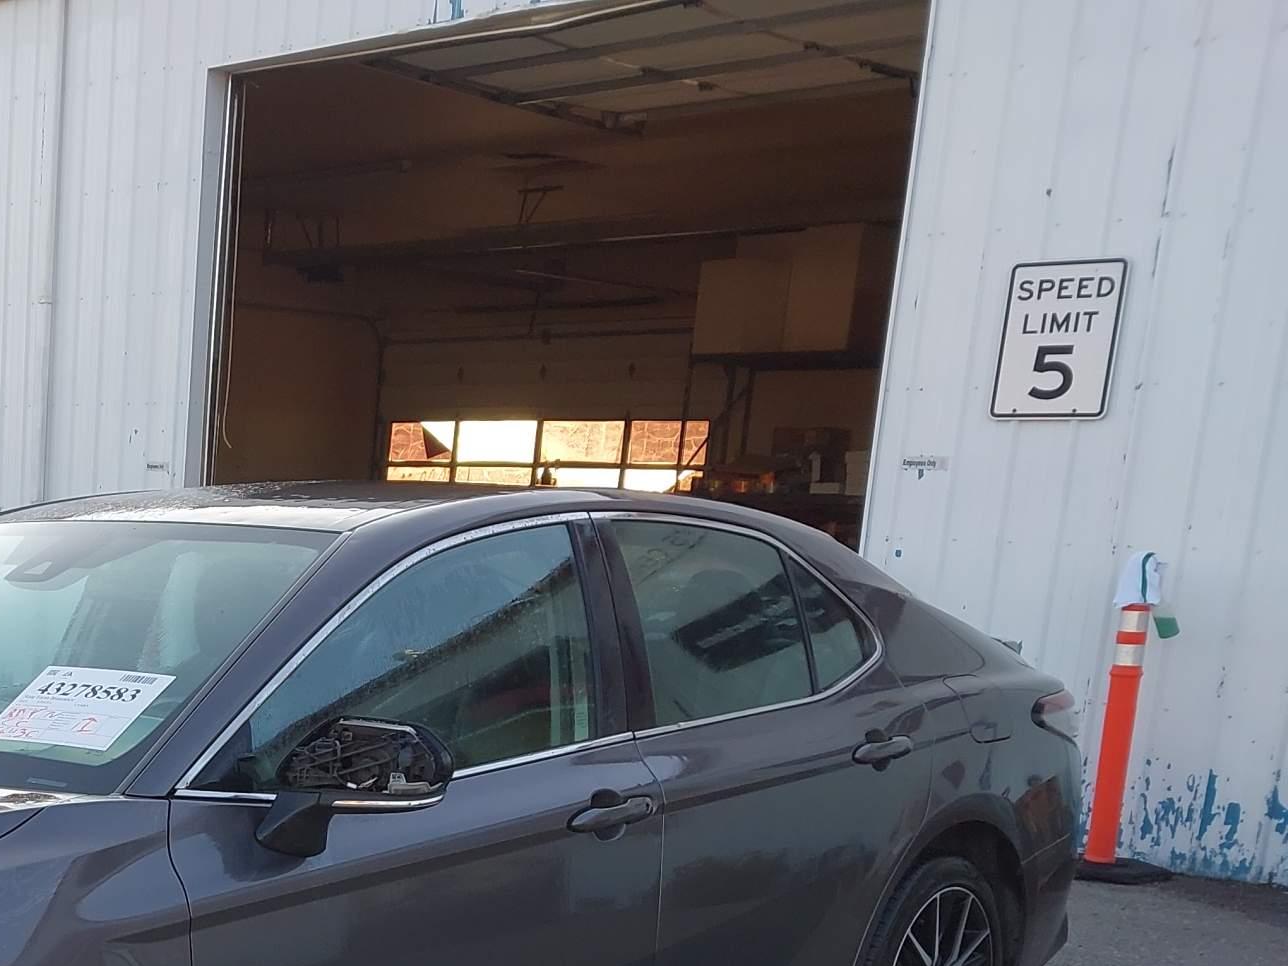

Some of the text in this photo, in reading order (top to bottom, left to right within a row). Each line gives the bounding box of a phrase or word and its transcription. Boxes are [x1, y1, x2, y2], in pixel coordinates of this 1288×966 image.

[1017, 276, 1115, 301] SPEED
[1022, 311, 1099, 334] LIMIT
[1028, 345, 1074, 400] 5
[37, 680, 142, 703] 43278583
